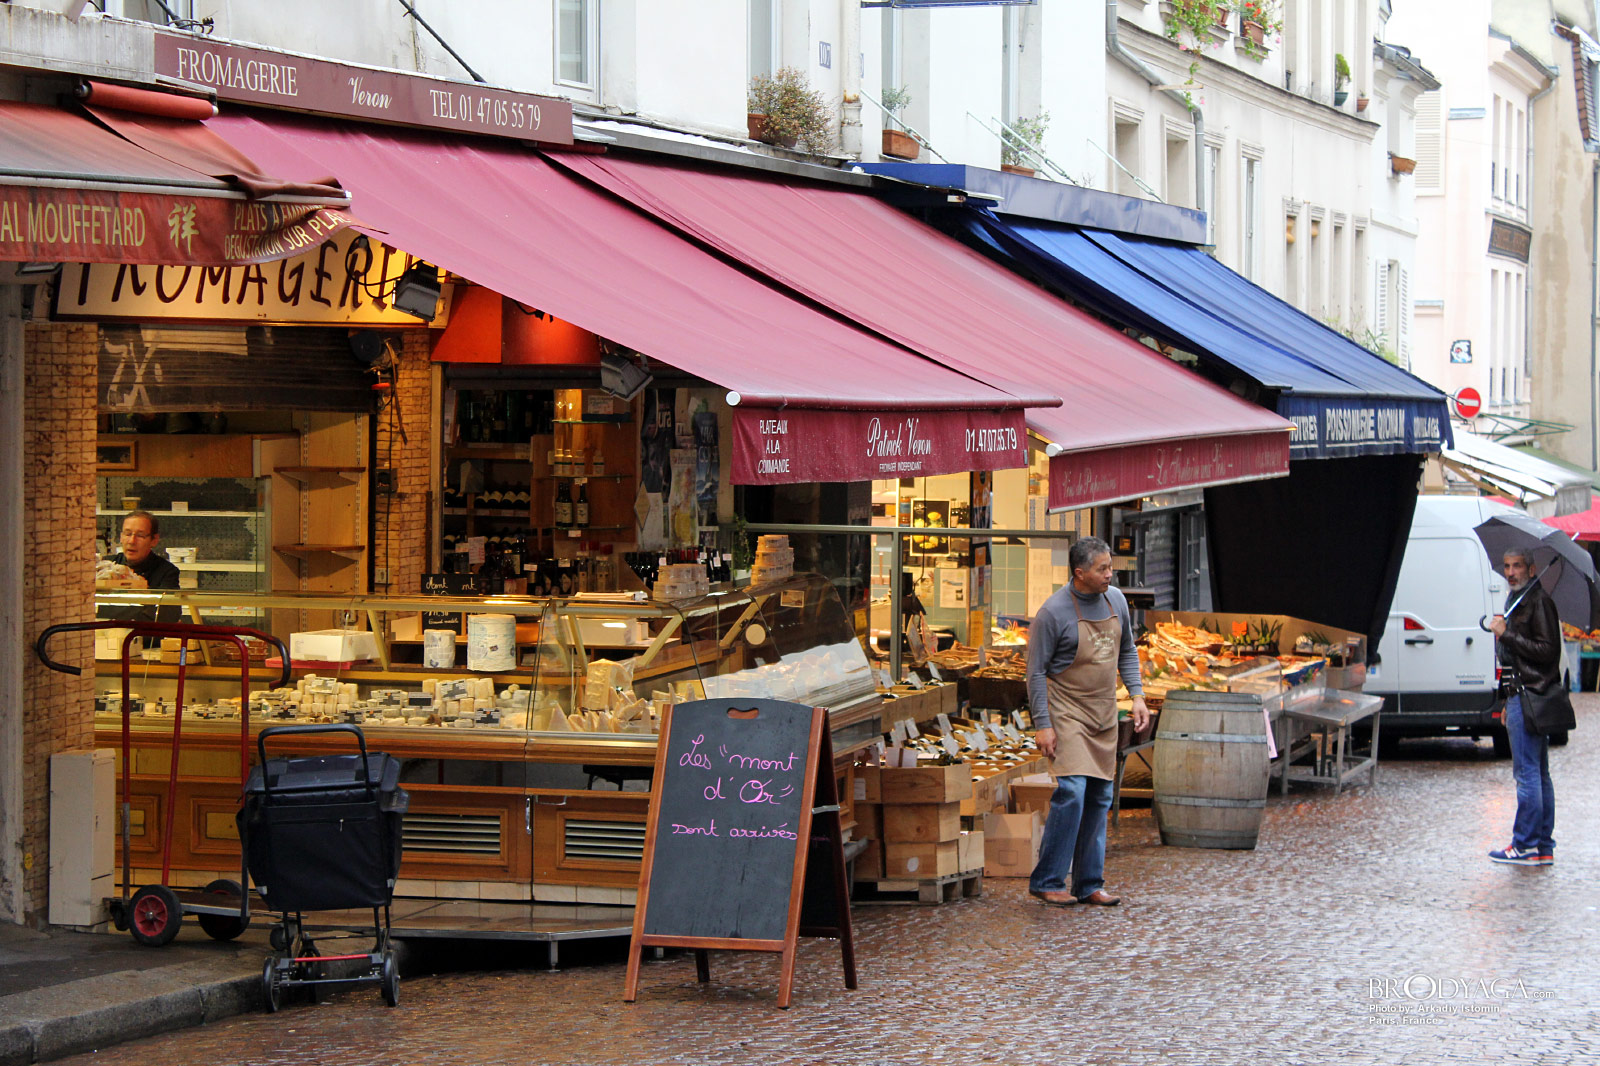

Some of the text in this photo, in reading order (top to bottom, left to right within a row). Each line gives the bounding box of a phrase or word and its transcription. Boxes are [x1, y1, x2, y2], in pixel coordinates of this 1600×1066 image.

[177, 48, 541, 131] FROMAGERIE Veron TEL 01 47 05 55 79
[28, 202, 146, 247] MOUFFETARD
[167, 202, 199, 256] 祥
[234, 203, 268, 231] PLATS
[282, 225, 314, 251] SUR
[78, 237, 414, 311] ROMAGERI
[759, 419, 789, 435] PLATEAUX
[867, 417, 931, 457] Patrick Veron
[766, 440, 781, 454] A LA
[679, 734, 712, 770] Les
[729, 822, 798, 840] arrivés
